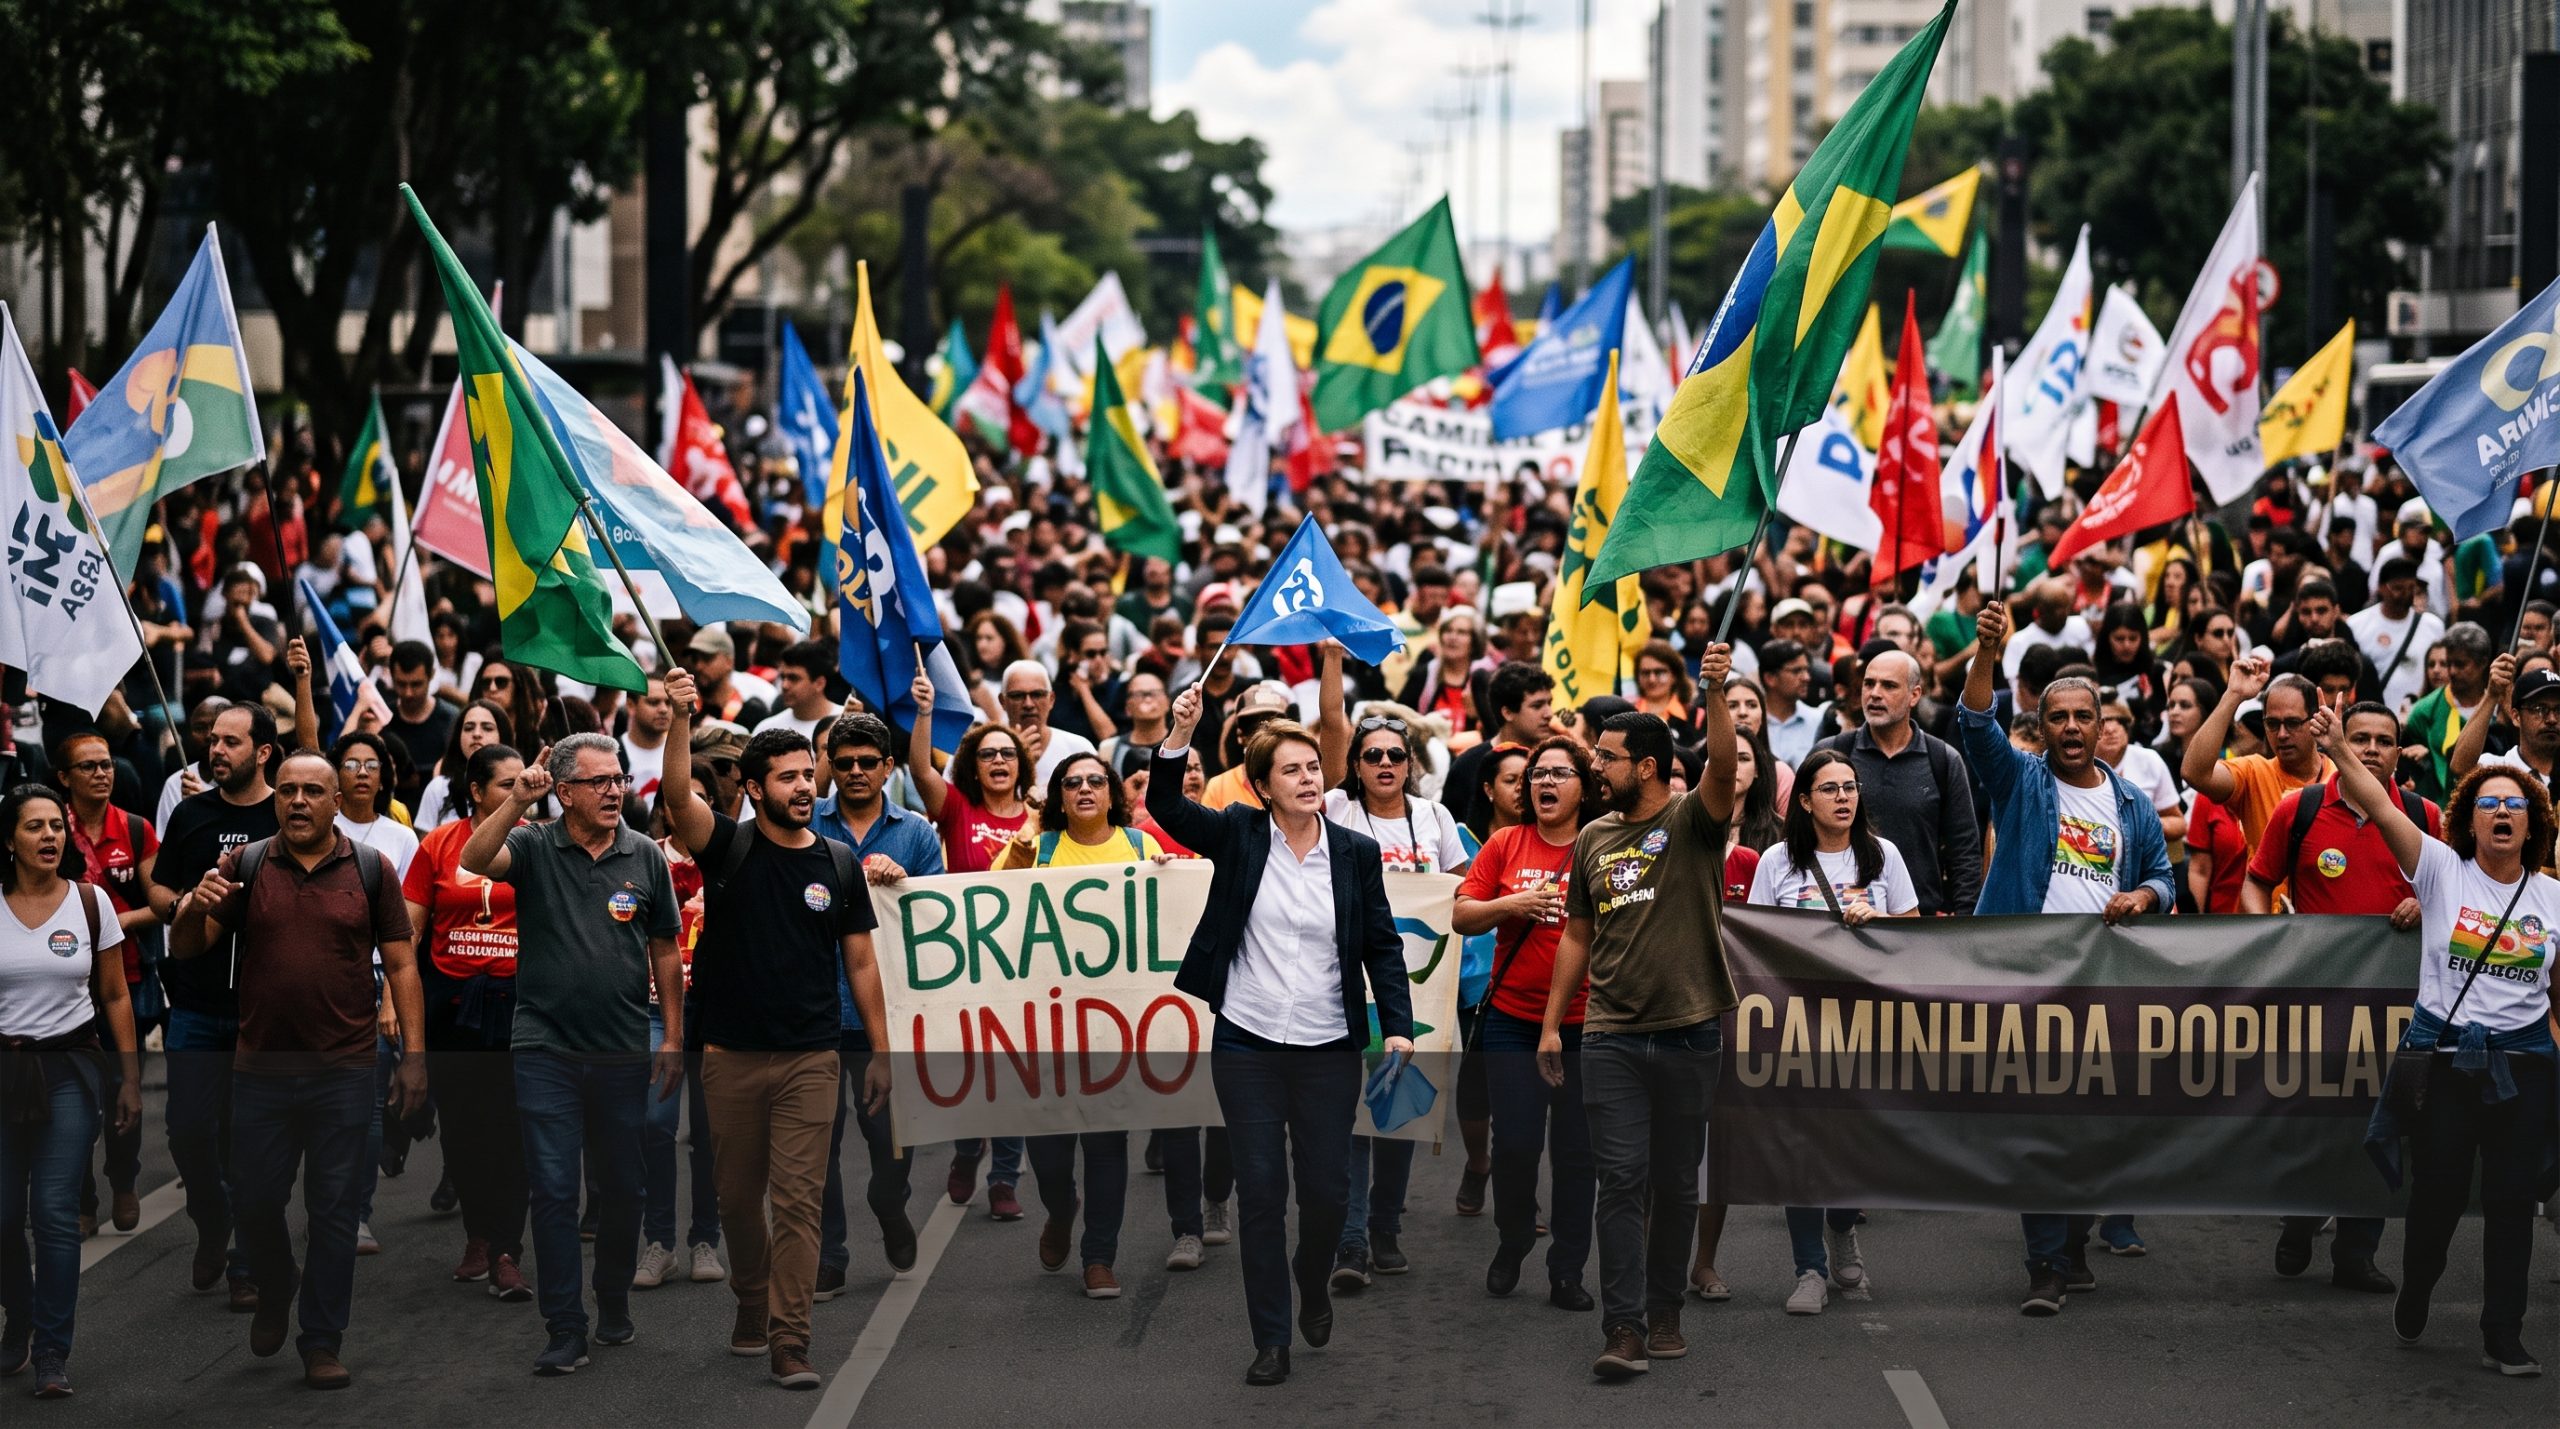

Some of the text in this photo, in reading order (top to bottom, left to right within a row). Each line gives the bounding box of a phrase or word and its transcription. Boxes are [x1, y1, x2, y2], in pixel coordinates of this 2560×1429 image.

[898, 866, 1184, 990] BRASIL
[912, 986, 1200, 1108] UNIDO
[1735, 993, 2118, 1097] CAMINHADA
